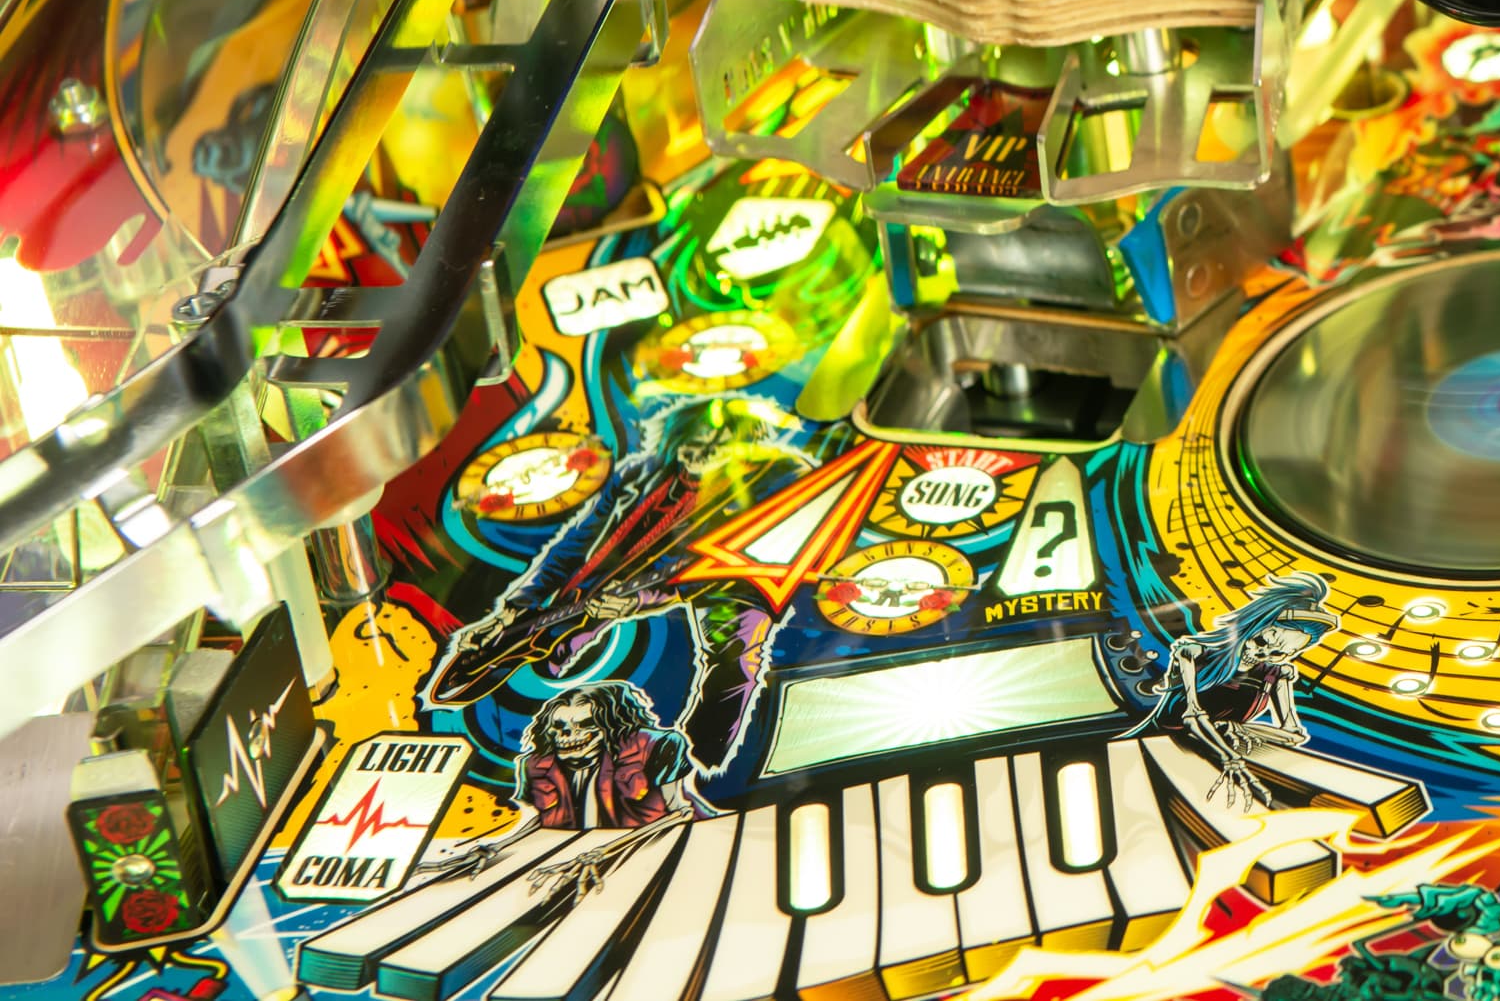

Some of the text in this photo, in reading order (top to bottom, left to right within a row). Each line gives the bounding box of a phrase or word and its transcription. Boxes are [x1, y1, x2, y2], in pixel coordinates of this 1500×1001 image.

[963, 134, 1028, 162] VIP
[560, 275, 656, 315] JAM
[925, 449, 1014, 474] START
[907, 479, 990, 509] SONG
[985, 592, 1103, 623] MYSTERY
[356, 743, 462, 773] LIGHT
[292, 855, 396, 888] COMA
